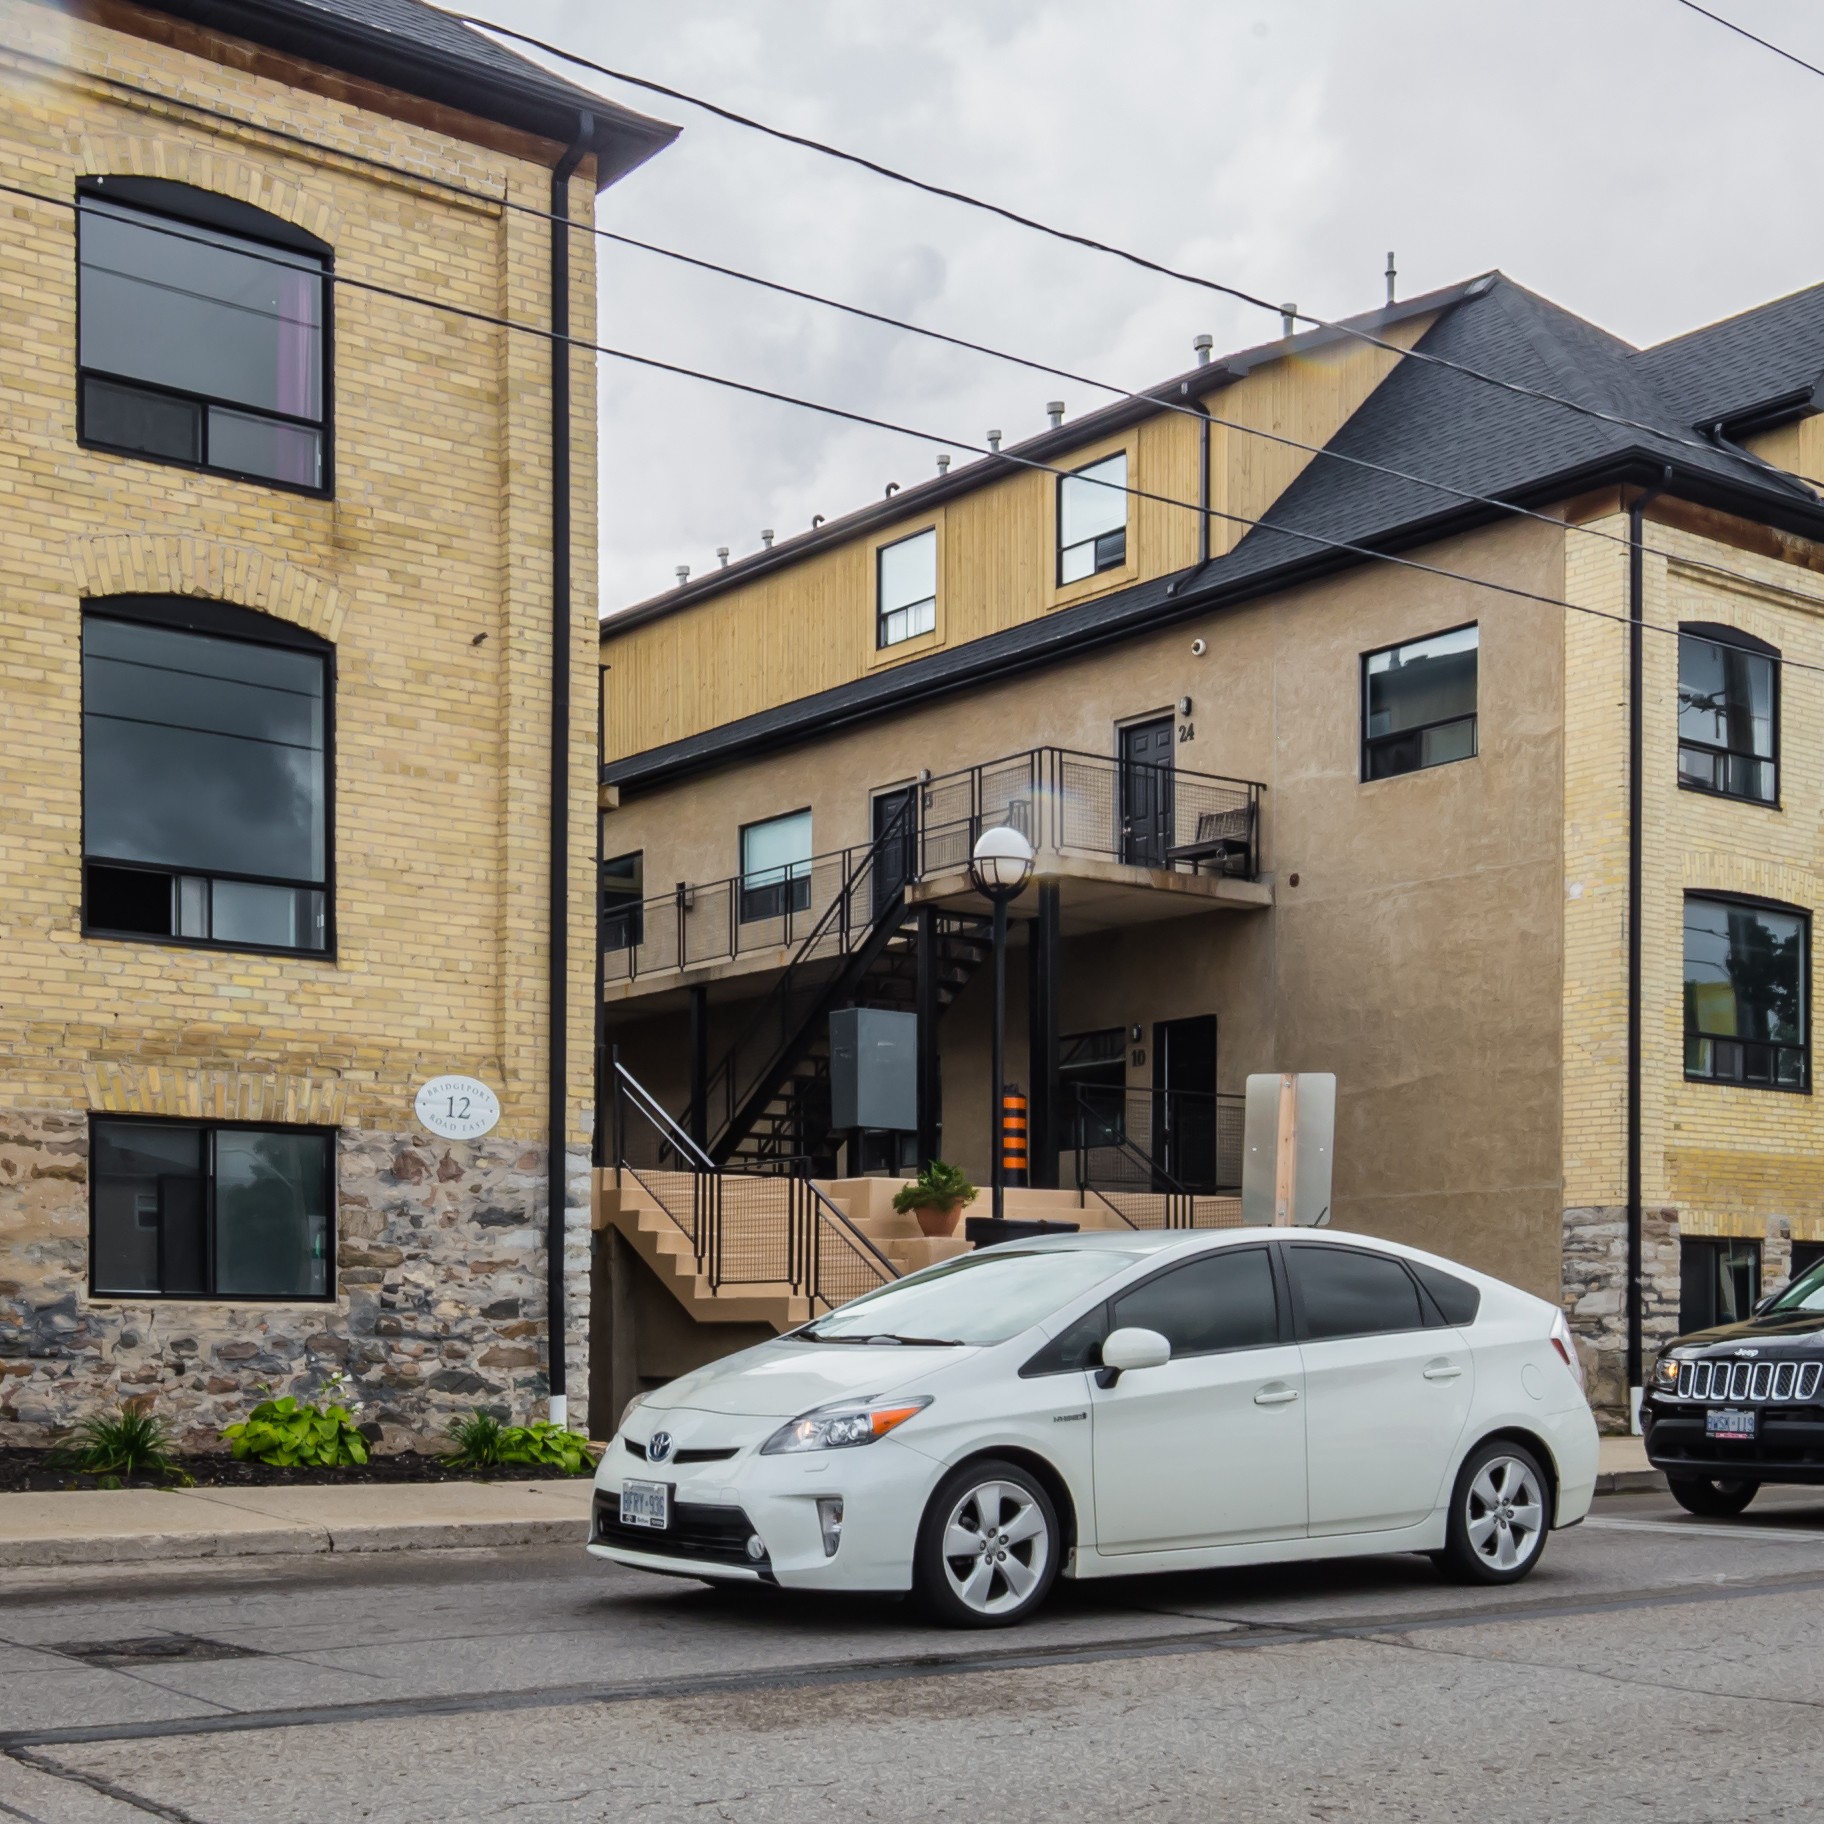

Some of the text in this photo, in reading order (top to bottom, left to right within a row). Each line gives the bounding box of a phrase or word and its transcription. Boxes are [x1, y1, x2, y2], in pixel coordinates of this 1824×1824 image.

[1179, 722, 1195, 743] 24
[1132, 1048, 1146, 1067] 10
[427, 1083, 490, 1103] BRIDGEPORT
[446, 1096, 471, 1119] 12
[429, 1113, 486, 1132] ROAD EAST
[1734, 1347, 1759, 1357] Jeep
